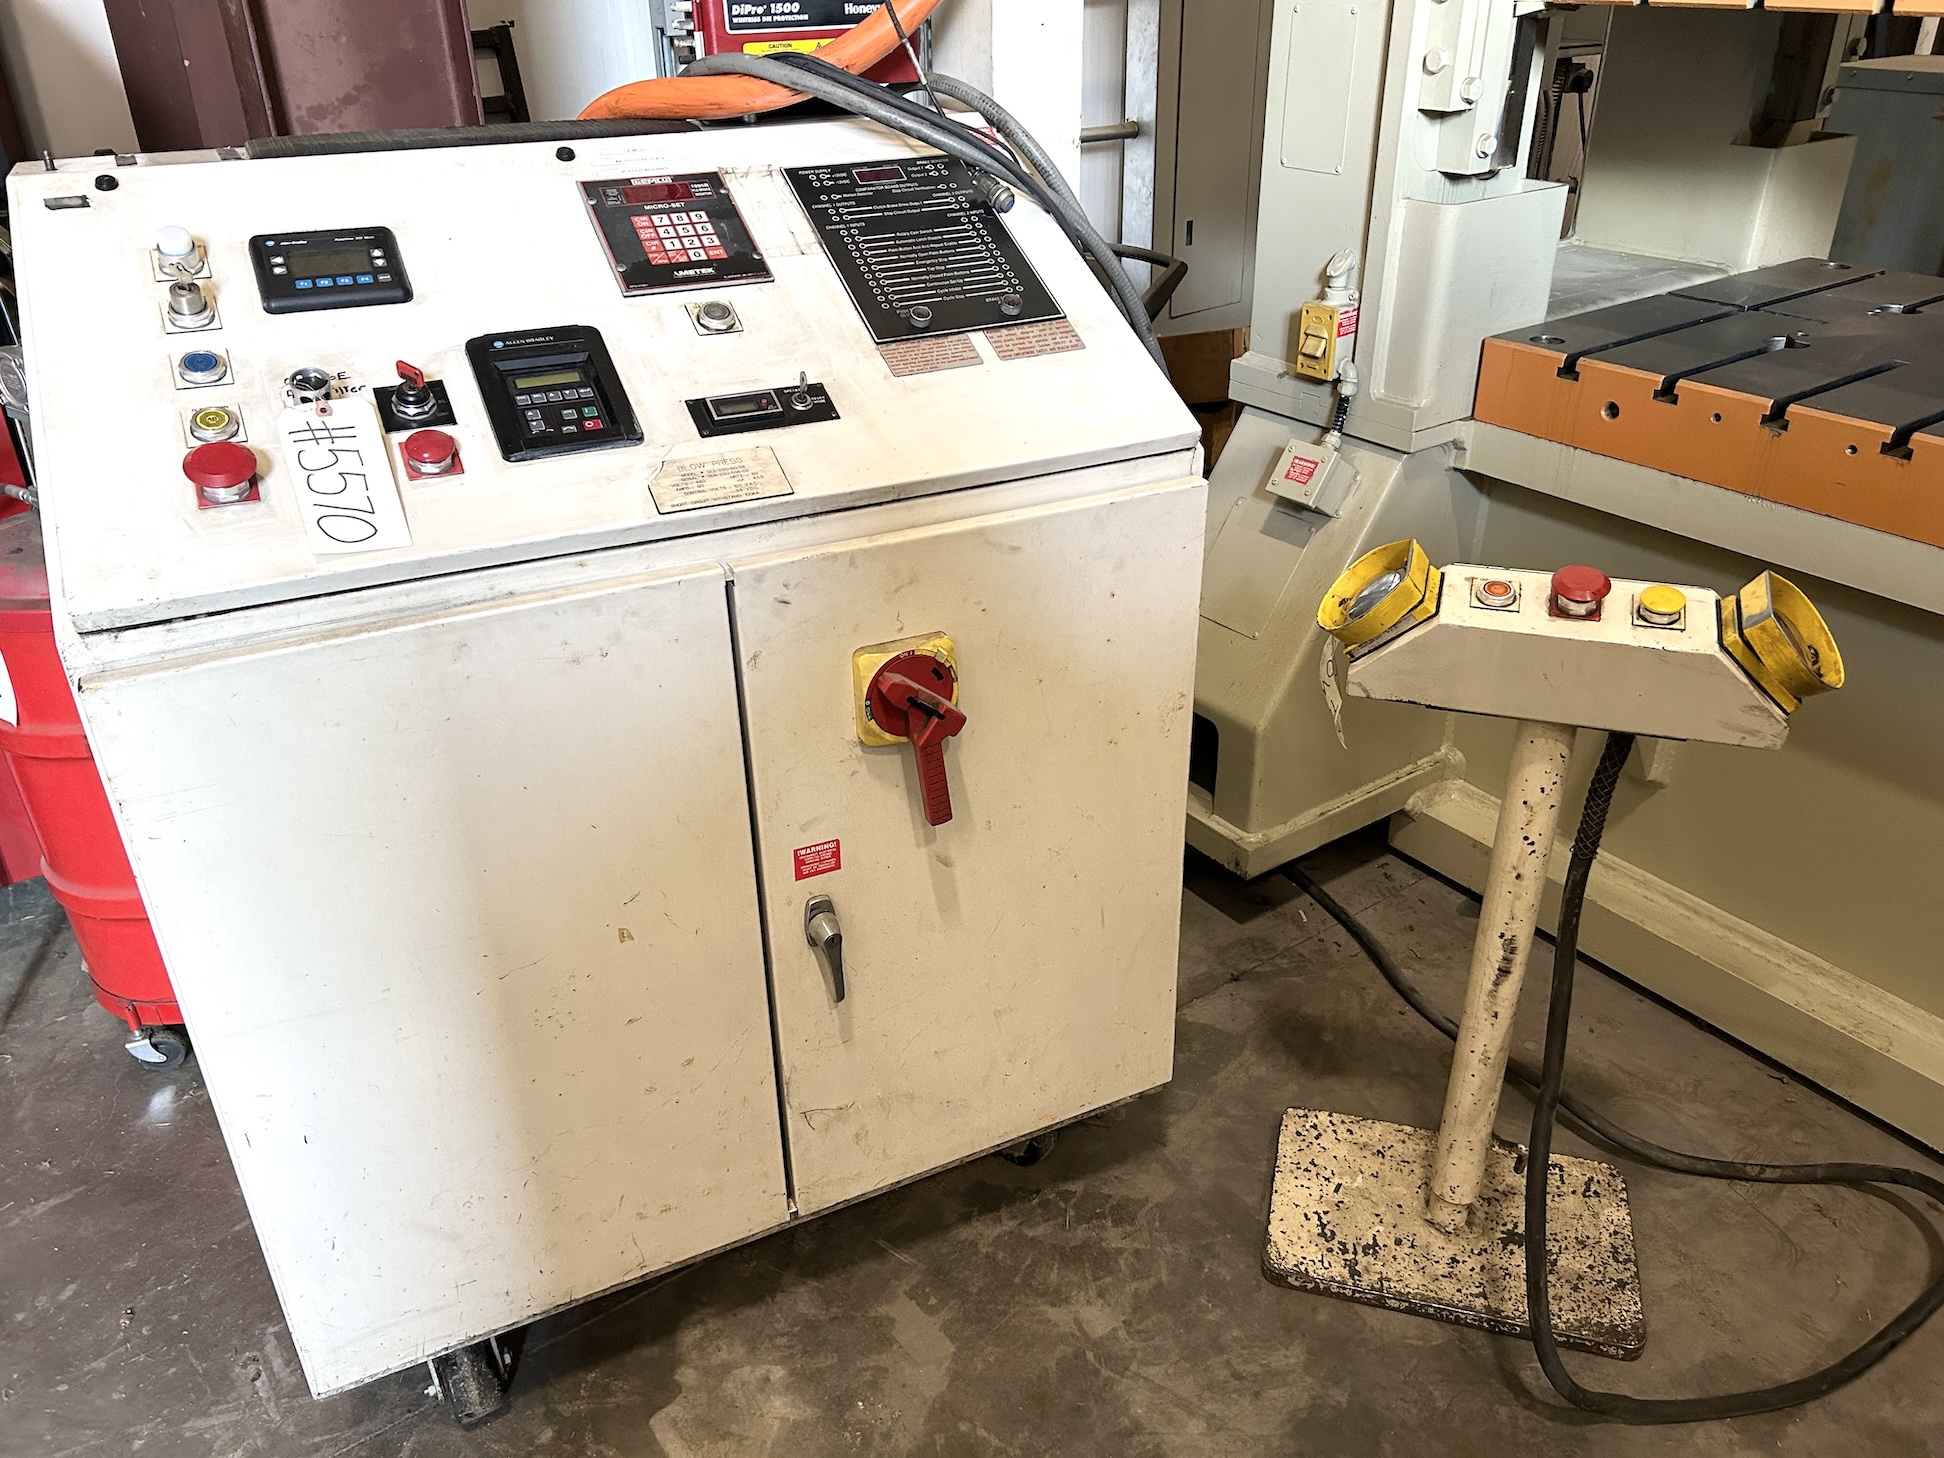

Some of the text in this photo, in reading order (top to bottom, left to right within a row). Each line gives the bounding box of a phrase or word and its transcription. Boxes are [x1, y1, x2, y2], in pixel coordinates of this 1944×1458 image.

[770, 2, 800, 14] 1500
[844, 3, 879, 15] Honey
[773, 14, 809, 22] PROTECTION
[643, 202, 685, 210] MICRO-SET
[673, 267, 716, 276] AMETEK
[677, 462, 706, 473] BLOW
[711, 456, 744, 467] PRESS
[288, 420, 378, 543] #5570
[797, 841, 837, 857] !WARNING!
